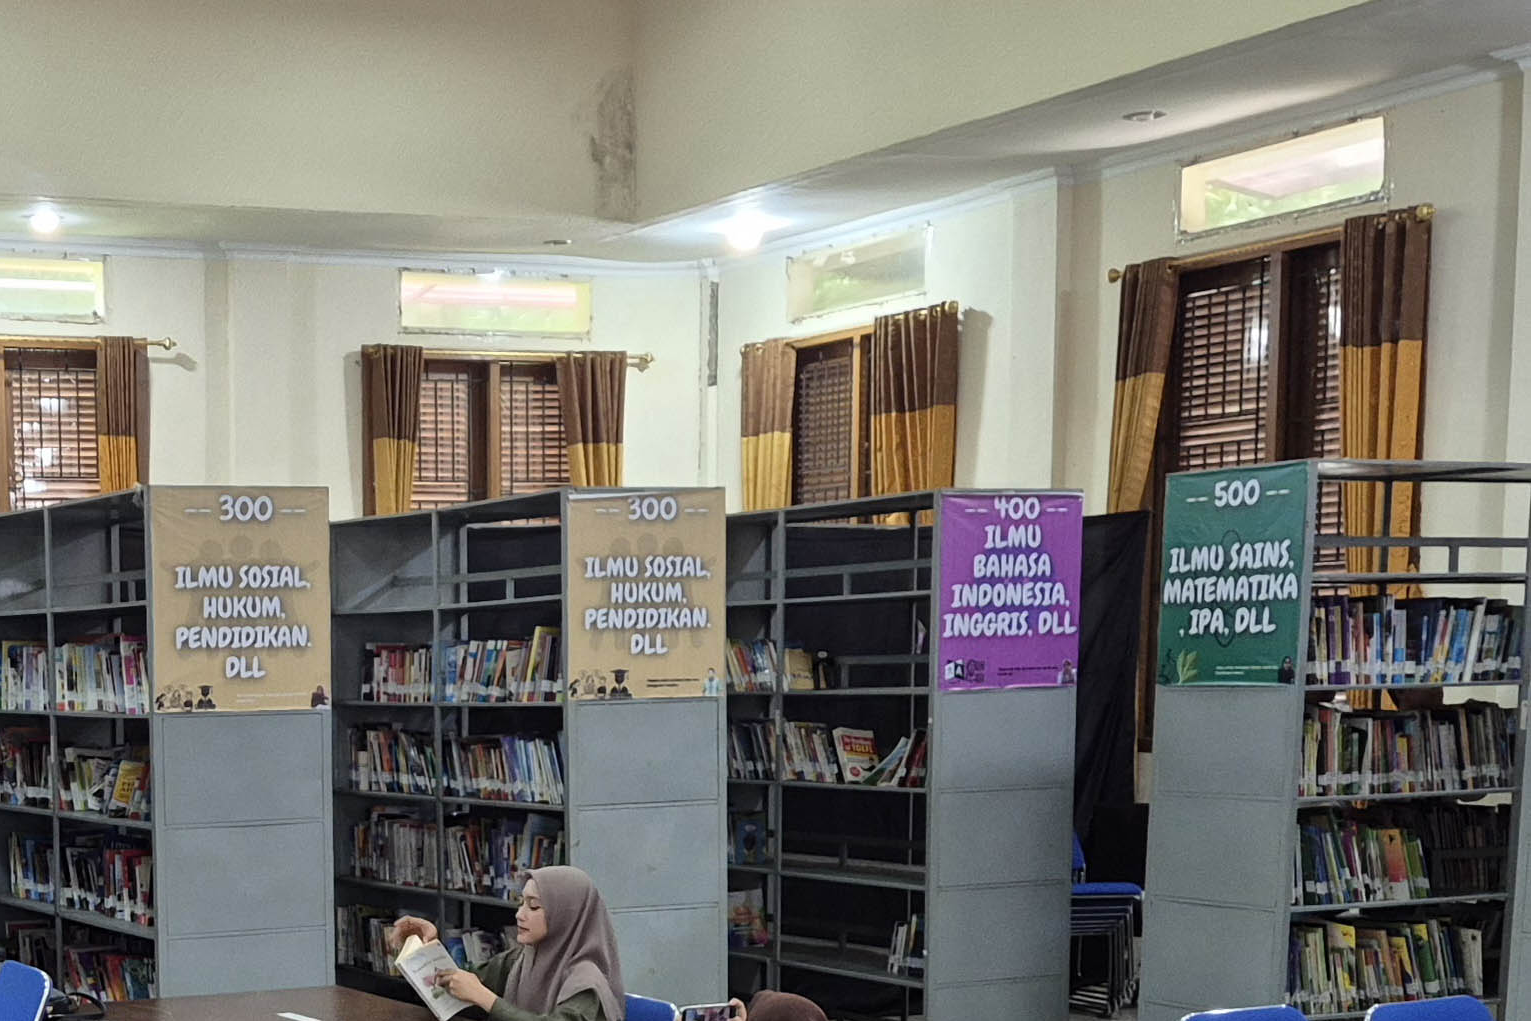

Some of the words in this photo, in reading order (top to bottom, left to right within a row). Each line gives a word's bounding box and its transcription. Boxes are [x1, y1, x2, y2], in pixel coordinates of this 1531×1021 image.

[1214, 478, 1260, 507] 500
[219, 494, 273, 521] 300
[627, 496, 677, 520] 300
[994, 497, 1040, 520] 400
[984, 525, 1041, 549] ILMU
[584, 556, 638, 578] ILMU
[644, 555, 711, 579] SOSIAL,
[973, 553, 1051, 578] BAHASA
[1168, 544, 1224, 573] ILMU
[1229, 539, 1294, 571] SAINS,
[174, 566, 233, 589] ILMU
[239, 565, 311, 590] SOSIAL,
[1163, 572, 1298, 604] MATEMATIKA
[610, 582, 687, 604] HUKUM,
[951, 582, 1070, 608] INDONESIA,
[203, 596, 285, 619] HUKUM,
[1234, 606, 1277, 634] DLL
[942, 611, 1033, 637] INGGRIS,
[1038, 611, 1078, 634] DLL
[630, 634, 668, 655] DLL
[225, 656, 266, 678] DLL
